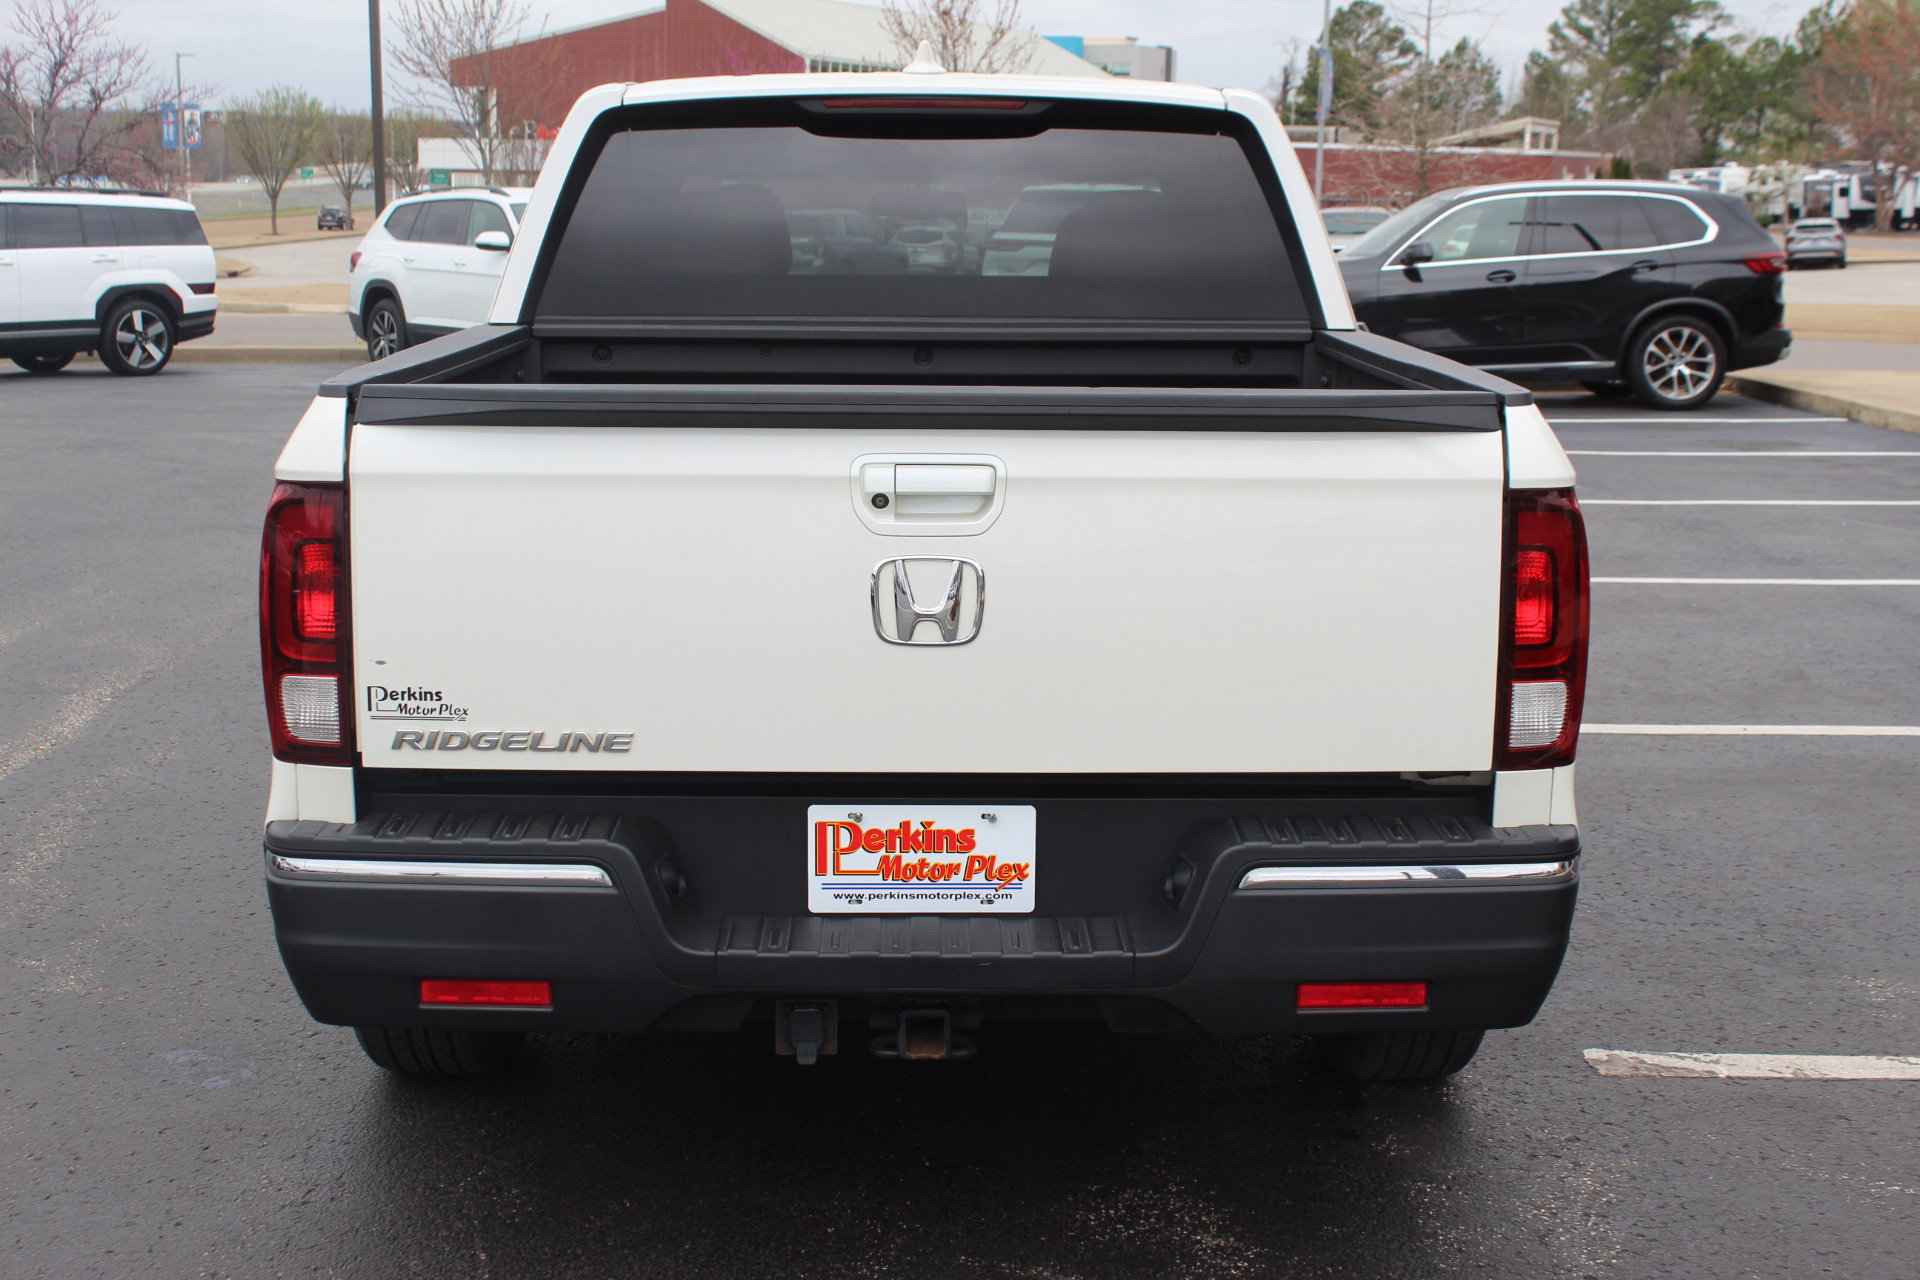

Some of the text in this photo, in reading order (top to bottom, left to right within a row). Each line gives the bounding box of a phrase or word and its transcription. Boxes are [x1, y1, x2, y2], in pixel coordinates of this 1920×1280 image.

[367, 686, 443, 711] Perkins
[397, 703, 468, 718] Motor Plex
[391, 730, 634, 753] RIDGELINE
[815, 820, 977, 876] Perkins
[877, 854, 1030, 891] Motor Plex
[833, 891, 1013, 901] www.perkinsmotorplex.com
